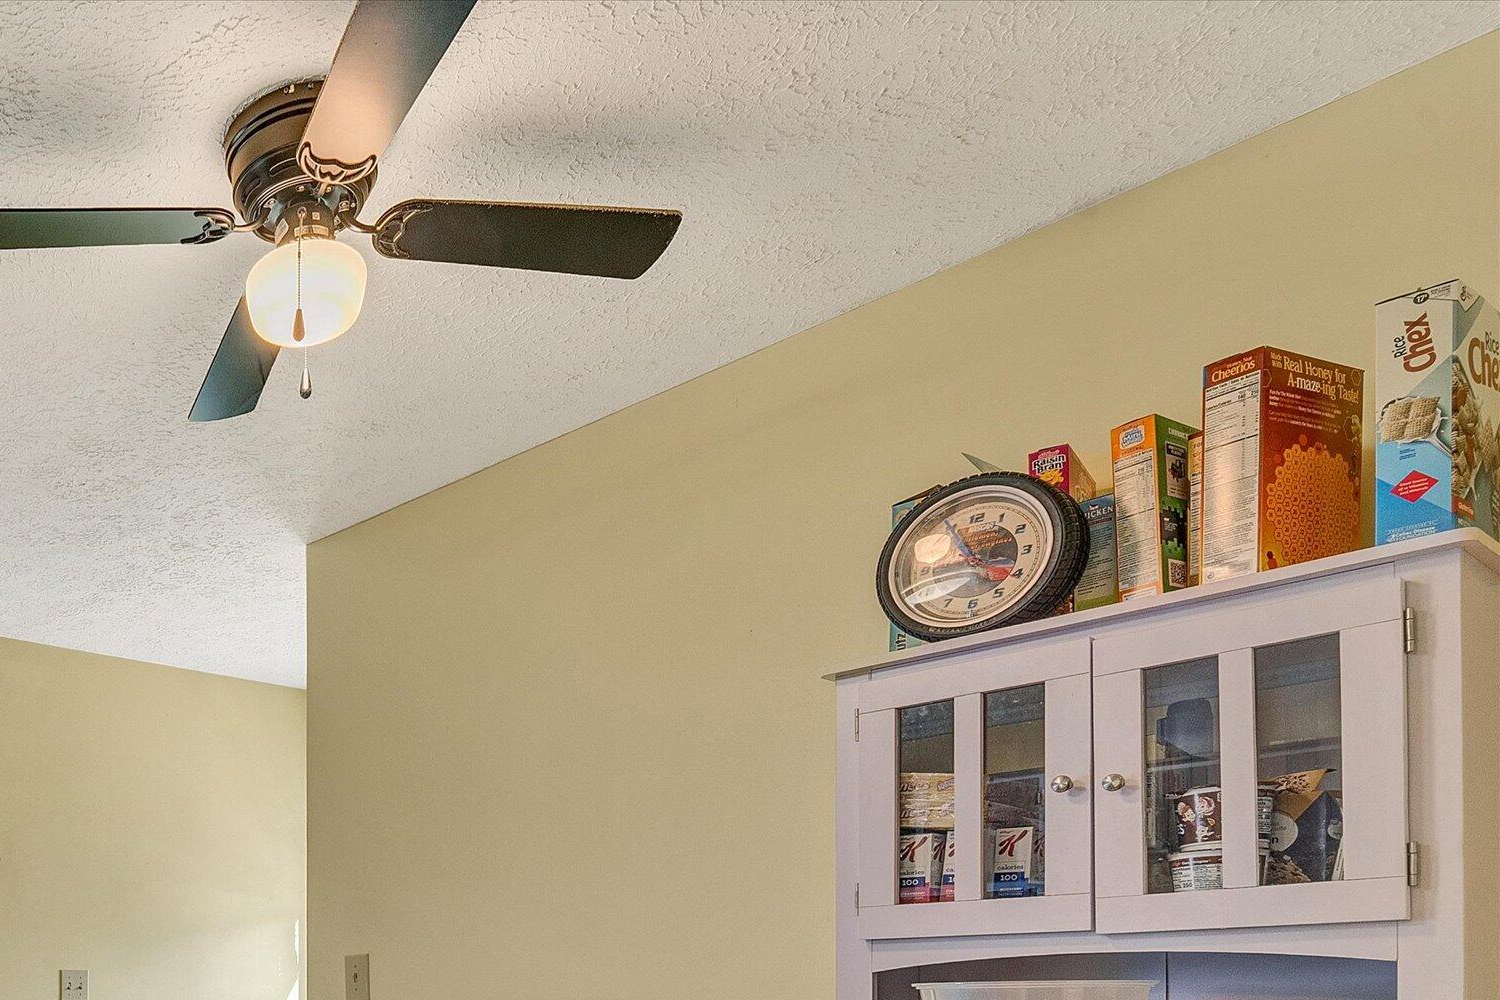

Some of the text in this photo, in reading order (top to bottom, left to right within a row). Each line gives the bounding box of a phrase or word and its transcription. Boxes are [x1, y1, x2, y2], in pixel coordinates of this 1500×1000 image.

[1392, 335, 1407, 358] Rice
[1403, 311, 1436, 372] Chex
[1284, 355, 1346, 384] Real Honey for
[1468, 337, 1500, 392] Che
[1211, 359, 1256, 382] Cheerios
[1287, 373, 1336, 400] A-maze-ing
[1034, 454, 1065, 469] Raisin
[1037, 462, 1062, 473] Bran
[969, 513, 985, 524] 12
[998, 513, 1005, 523] 1
[1015, 524, 1026, 534] 2
[1021, 544, 1032, 555] 3
[1013, 567, 1024, 579] 4
[993, 587, 1005, 598] 5
[944, 598, 954, 608] 7
[967, 599, 978, 608] 6
